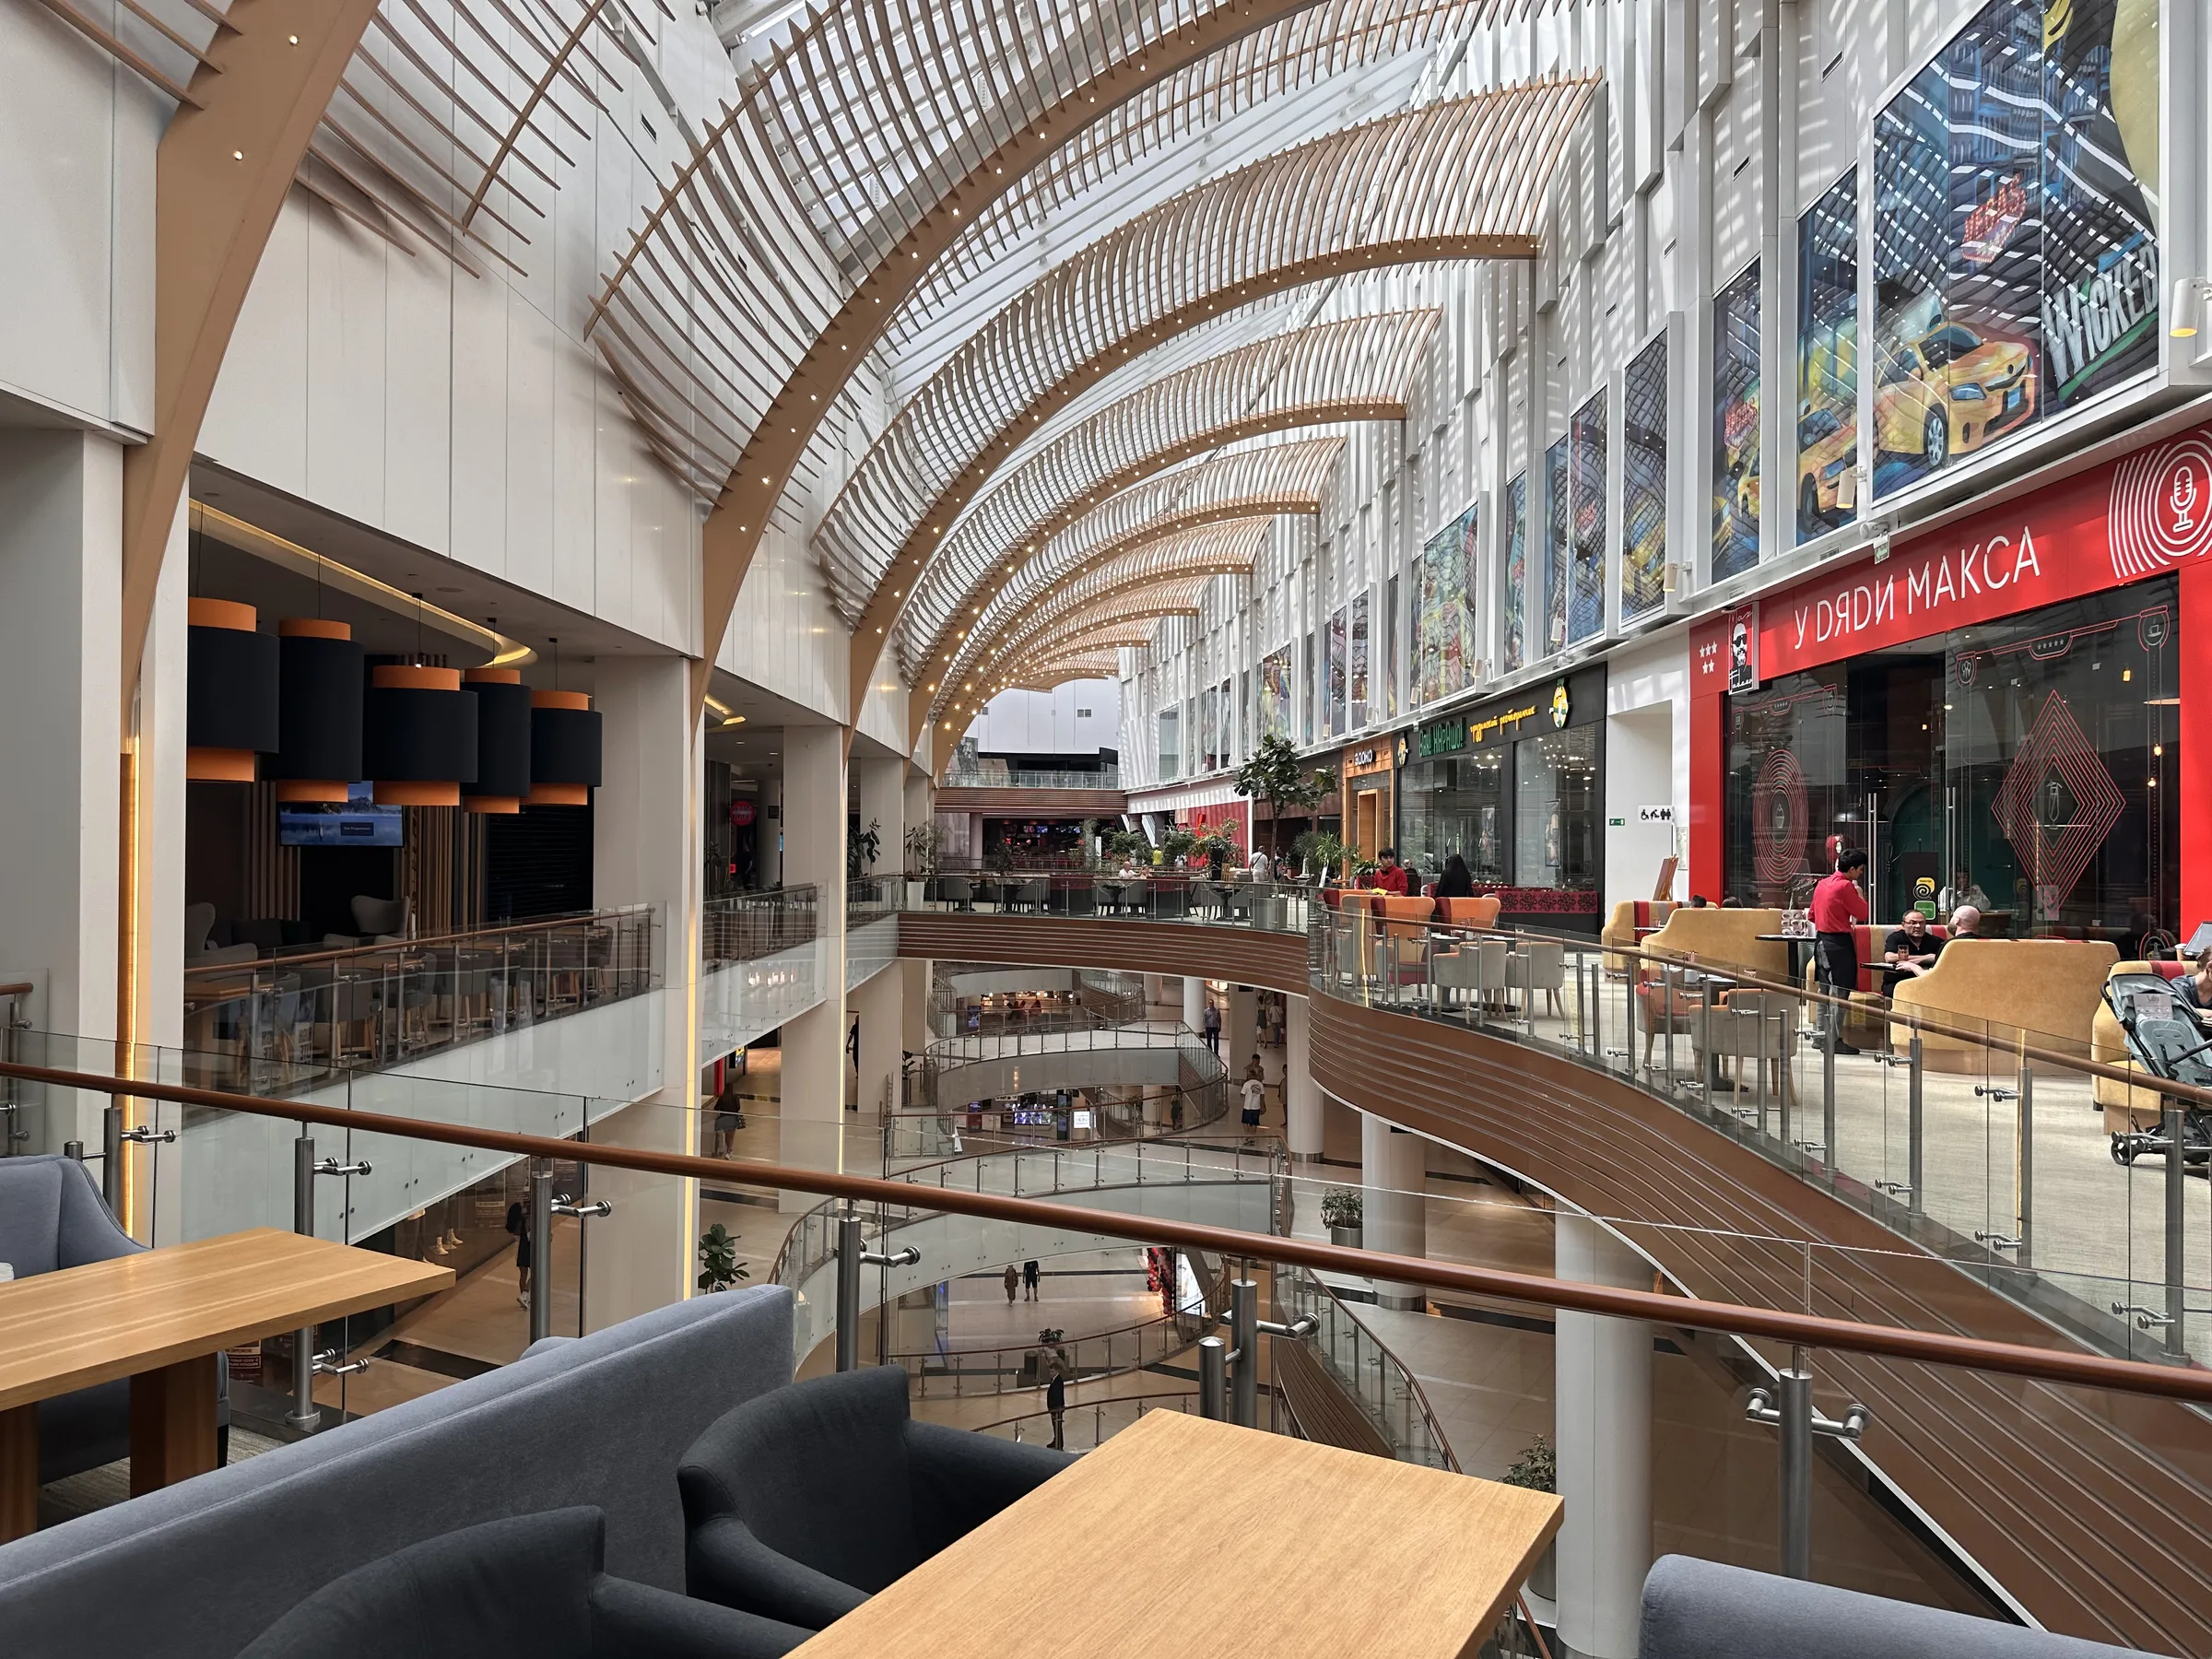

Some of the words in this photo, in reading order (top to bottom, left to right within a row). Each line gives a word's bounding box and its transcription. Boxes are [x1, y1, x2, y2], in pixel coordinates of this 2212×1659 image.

[2043, 241, 2159, 388] WICKED
[1794, 606, 1808, 649] У
[1907, 525, 2041, 615] МАКСА
